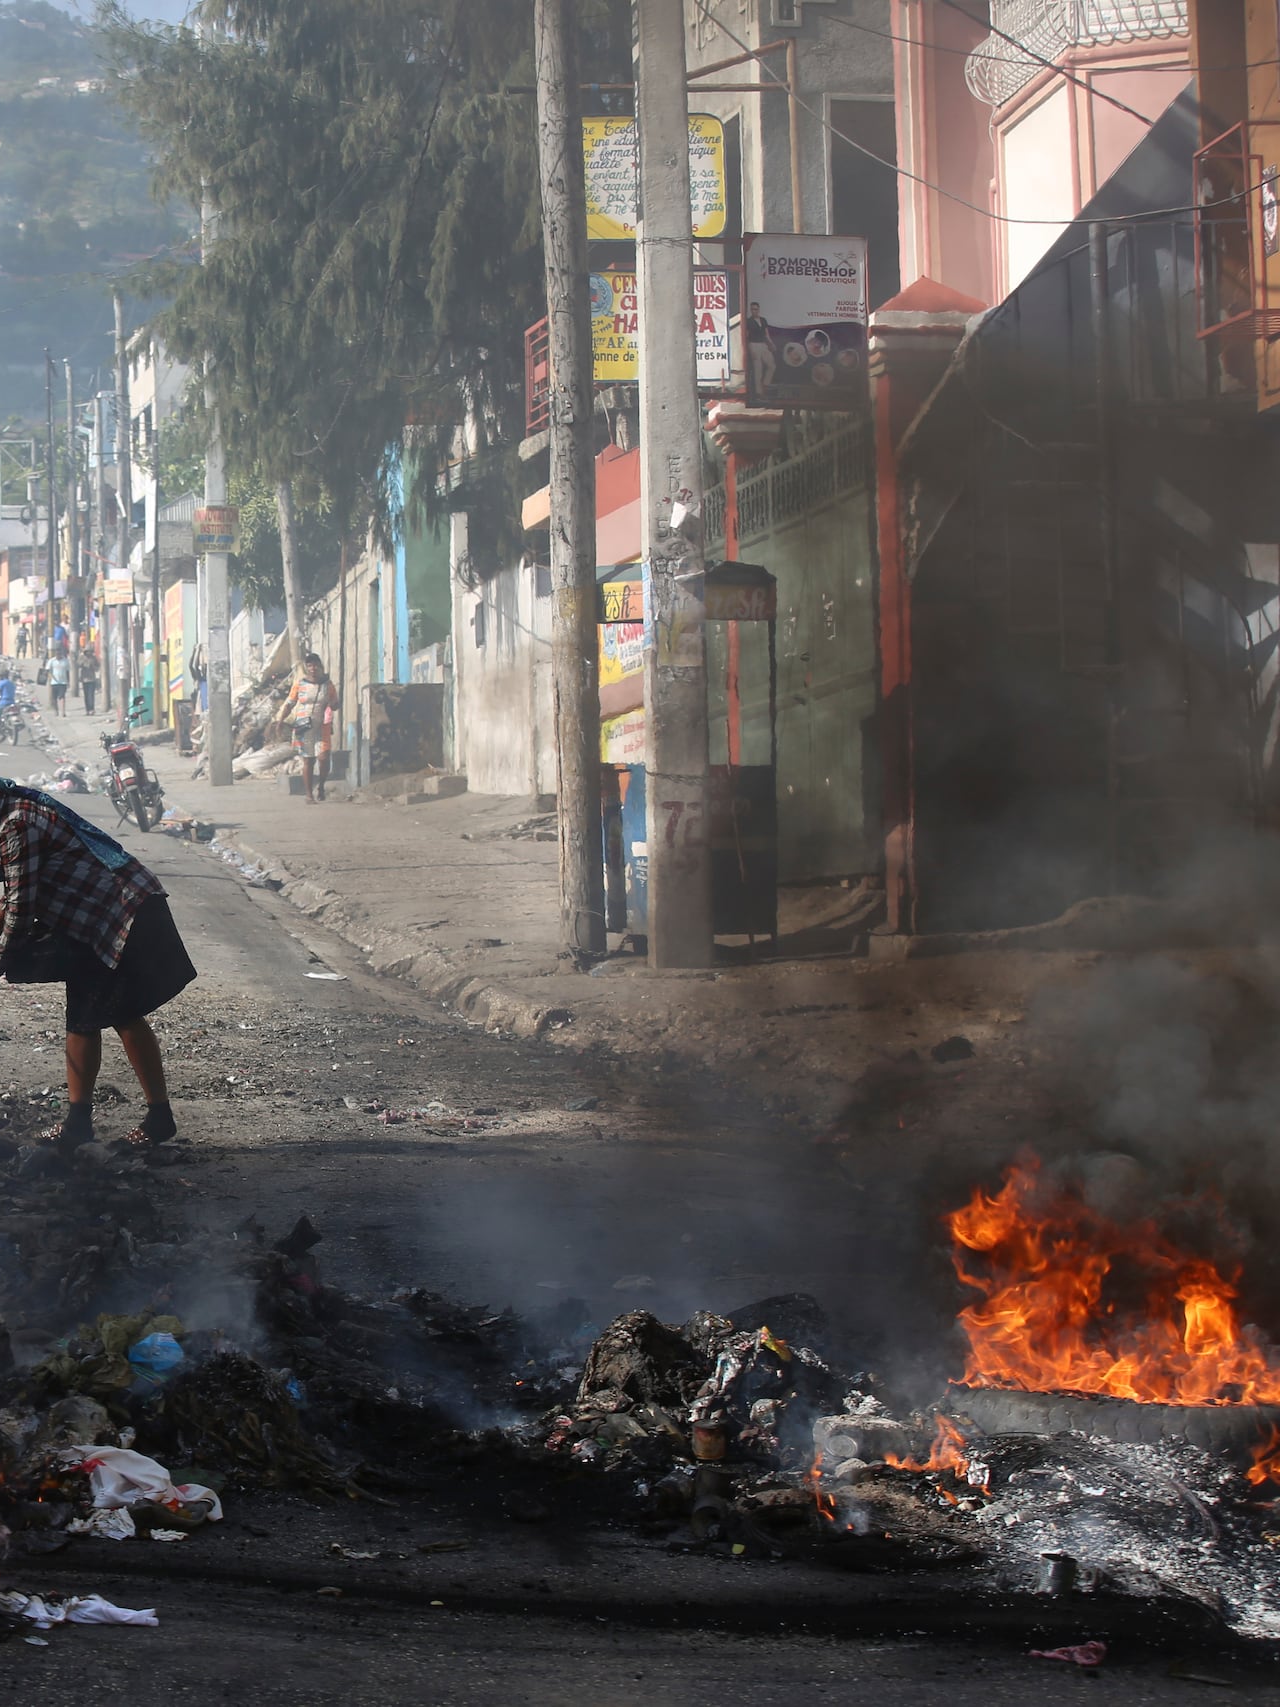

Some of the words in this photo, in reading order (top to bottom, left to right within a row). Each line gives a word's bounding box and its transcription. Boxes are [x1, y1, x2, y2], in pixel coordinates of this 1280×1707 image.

[688, 146, 717, 159] nique
[584, 158, 623, 169] ualité
[767, 256, 828, 268] DOMOND
[767, 265, 857, 278] BARBERSHOP
[695, 274, 726, 293] UDES
[821, 277, 857, 285] BOUTIQUE
